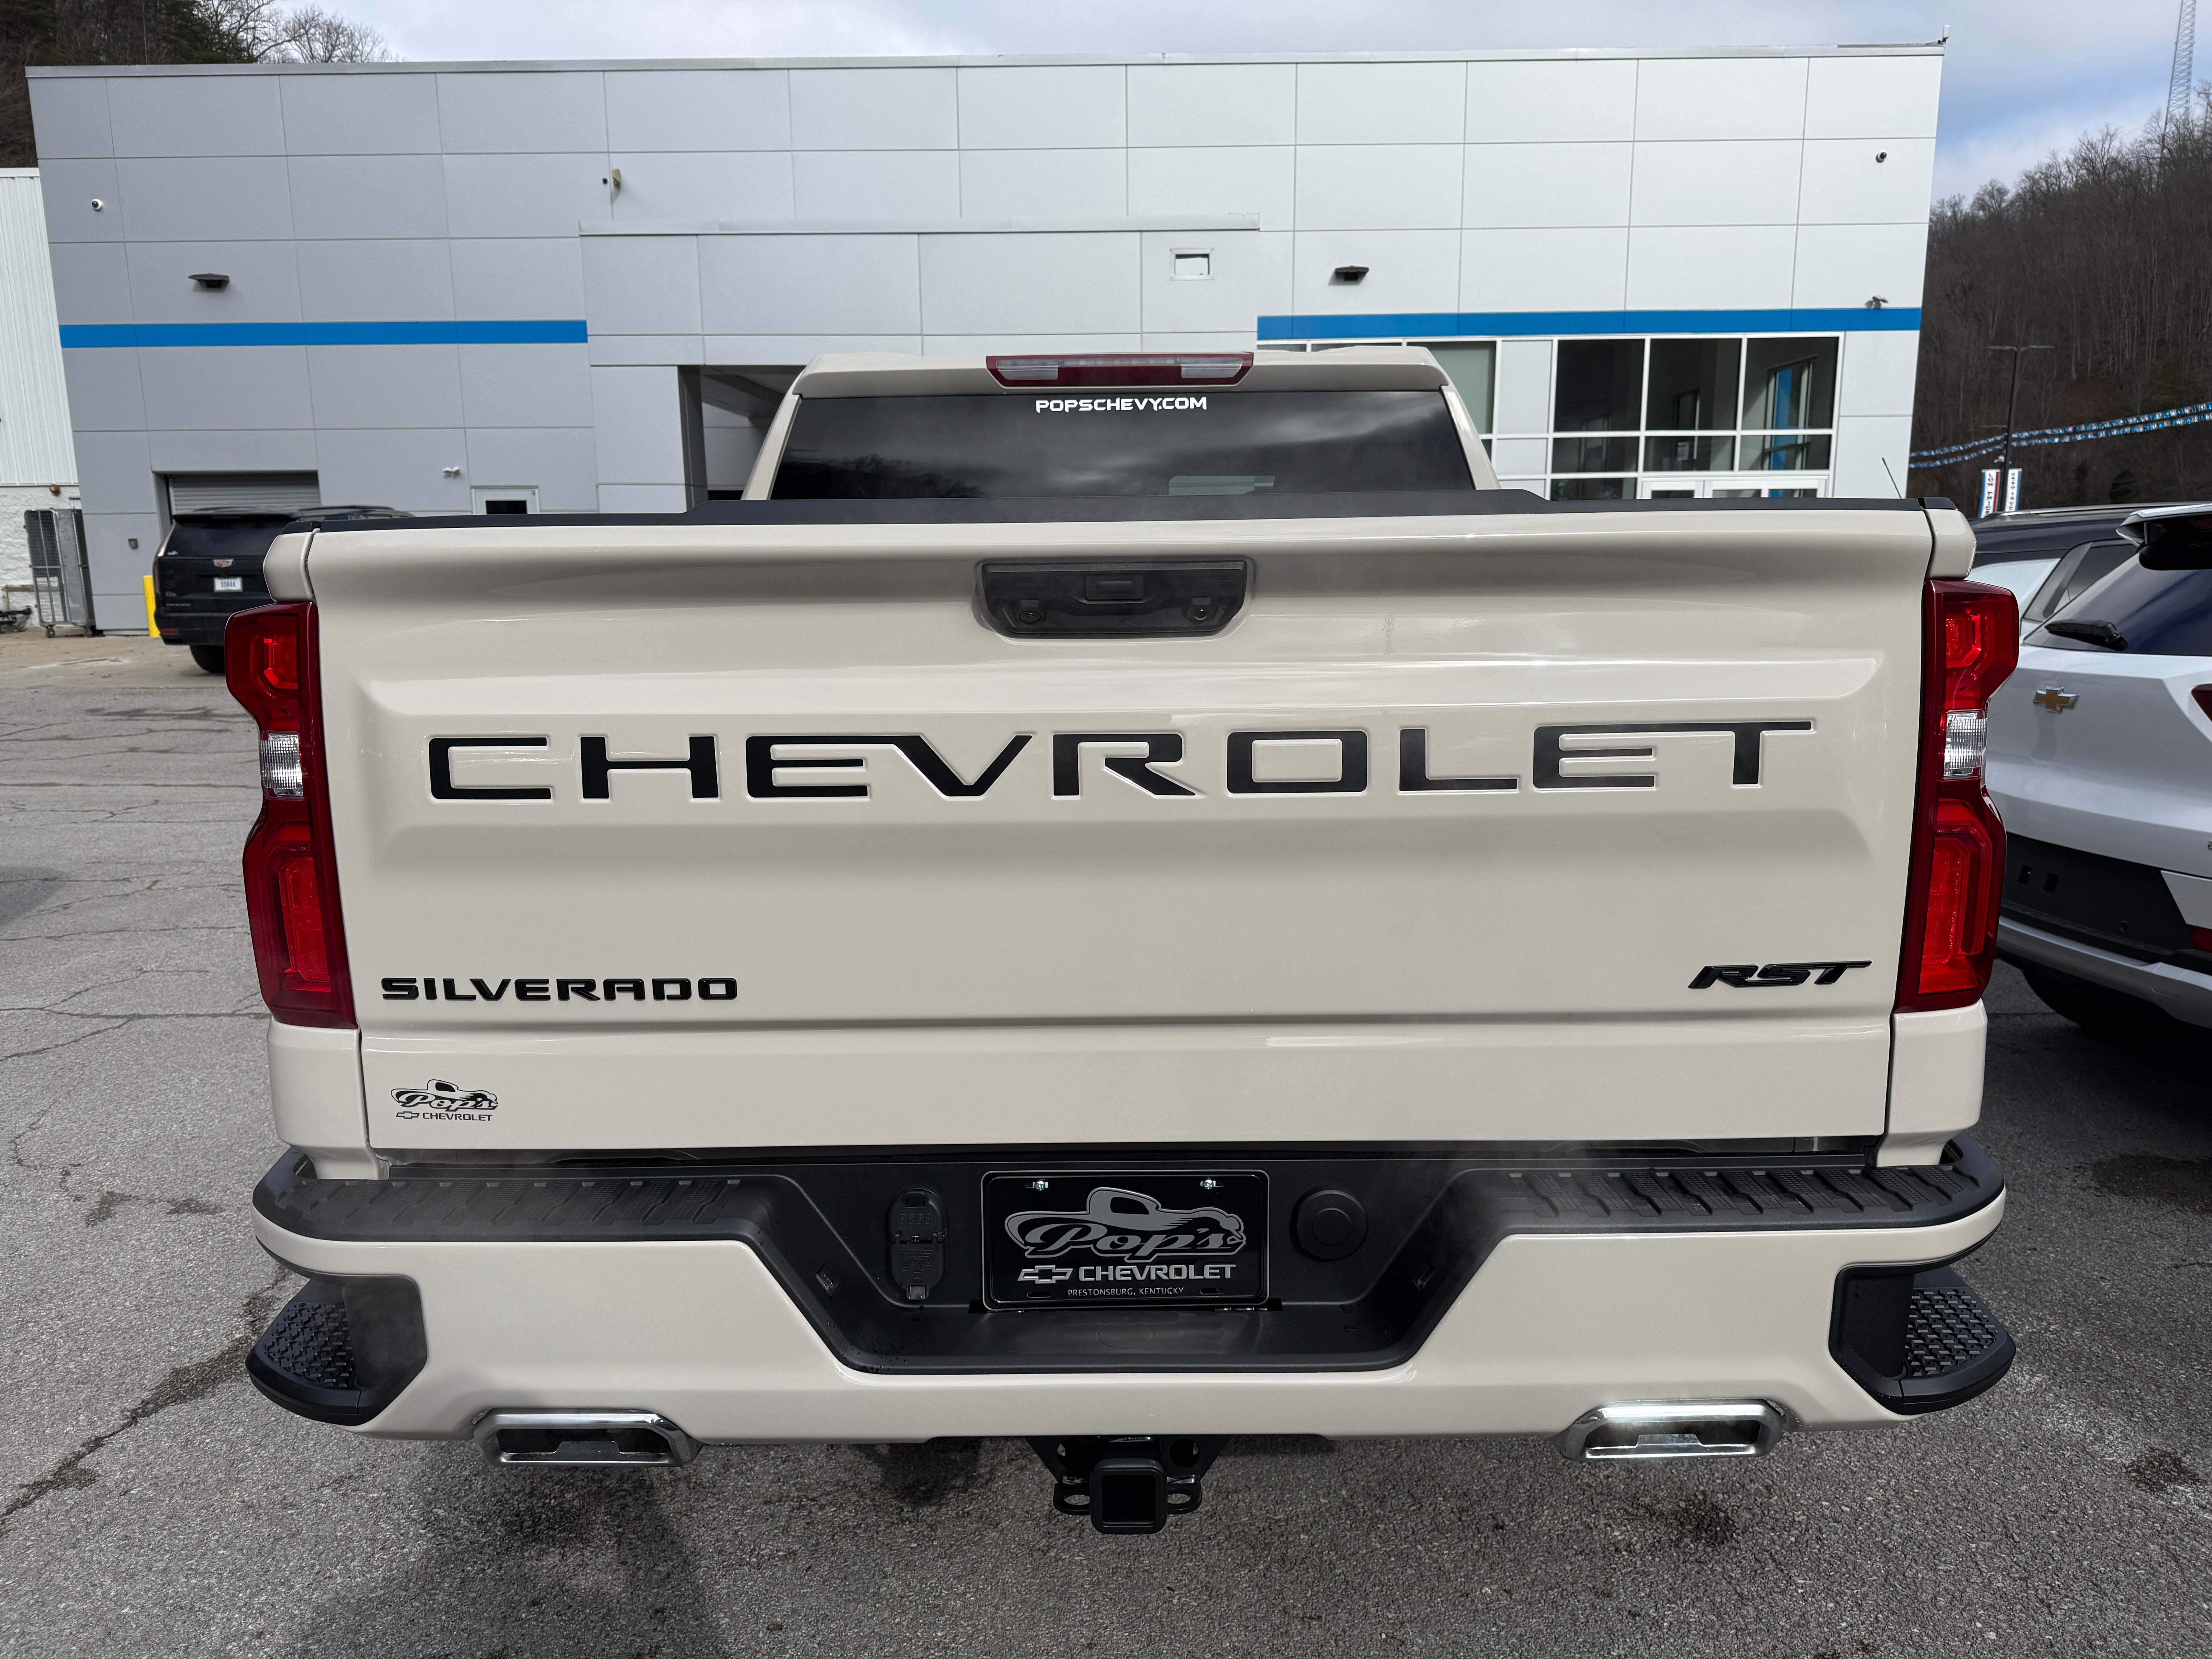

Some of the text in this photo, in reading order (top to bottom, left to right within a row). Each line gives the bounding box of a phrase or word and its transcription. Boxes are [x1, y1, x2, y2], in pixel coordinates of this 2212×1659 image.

[1036, 397, 1207, 413] POPSCHEVY.COM
[429, 721, 1812, 800] CHEVROLET
[1688, 960, 1872, 989] RST
[381, 977, 738, 1001] SILVERADO
[399, 1092, 493, 1111] Pop's
[422, 1113, 493, 1121] CHEVROLET
[1025, 1222, 1231, 1256] Pop's
[1079, 1264, 1237, 1281] CHEVROLET
[1068, 1287, 1184, 1297] PRESTONSBURG, KENTUCKY
